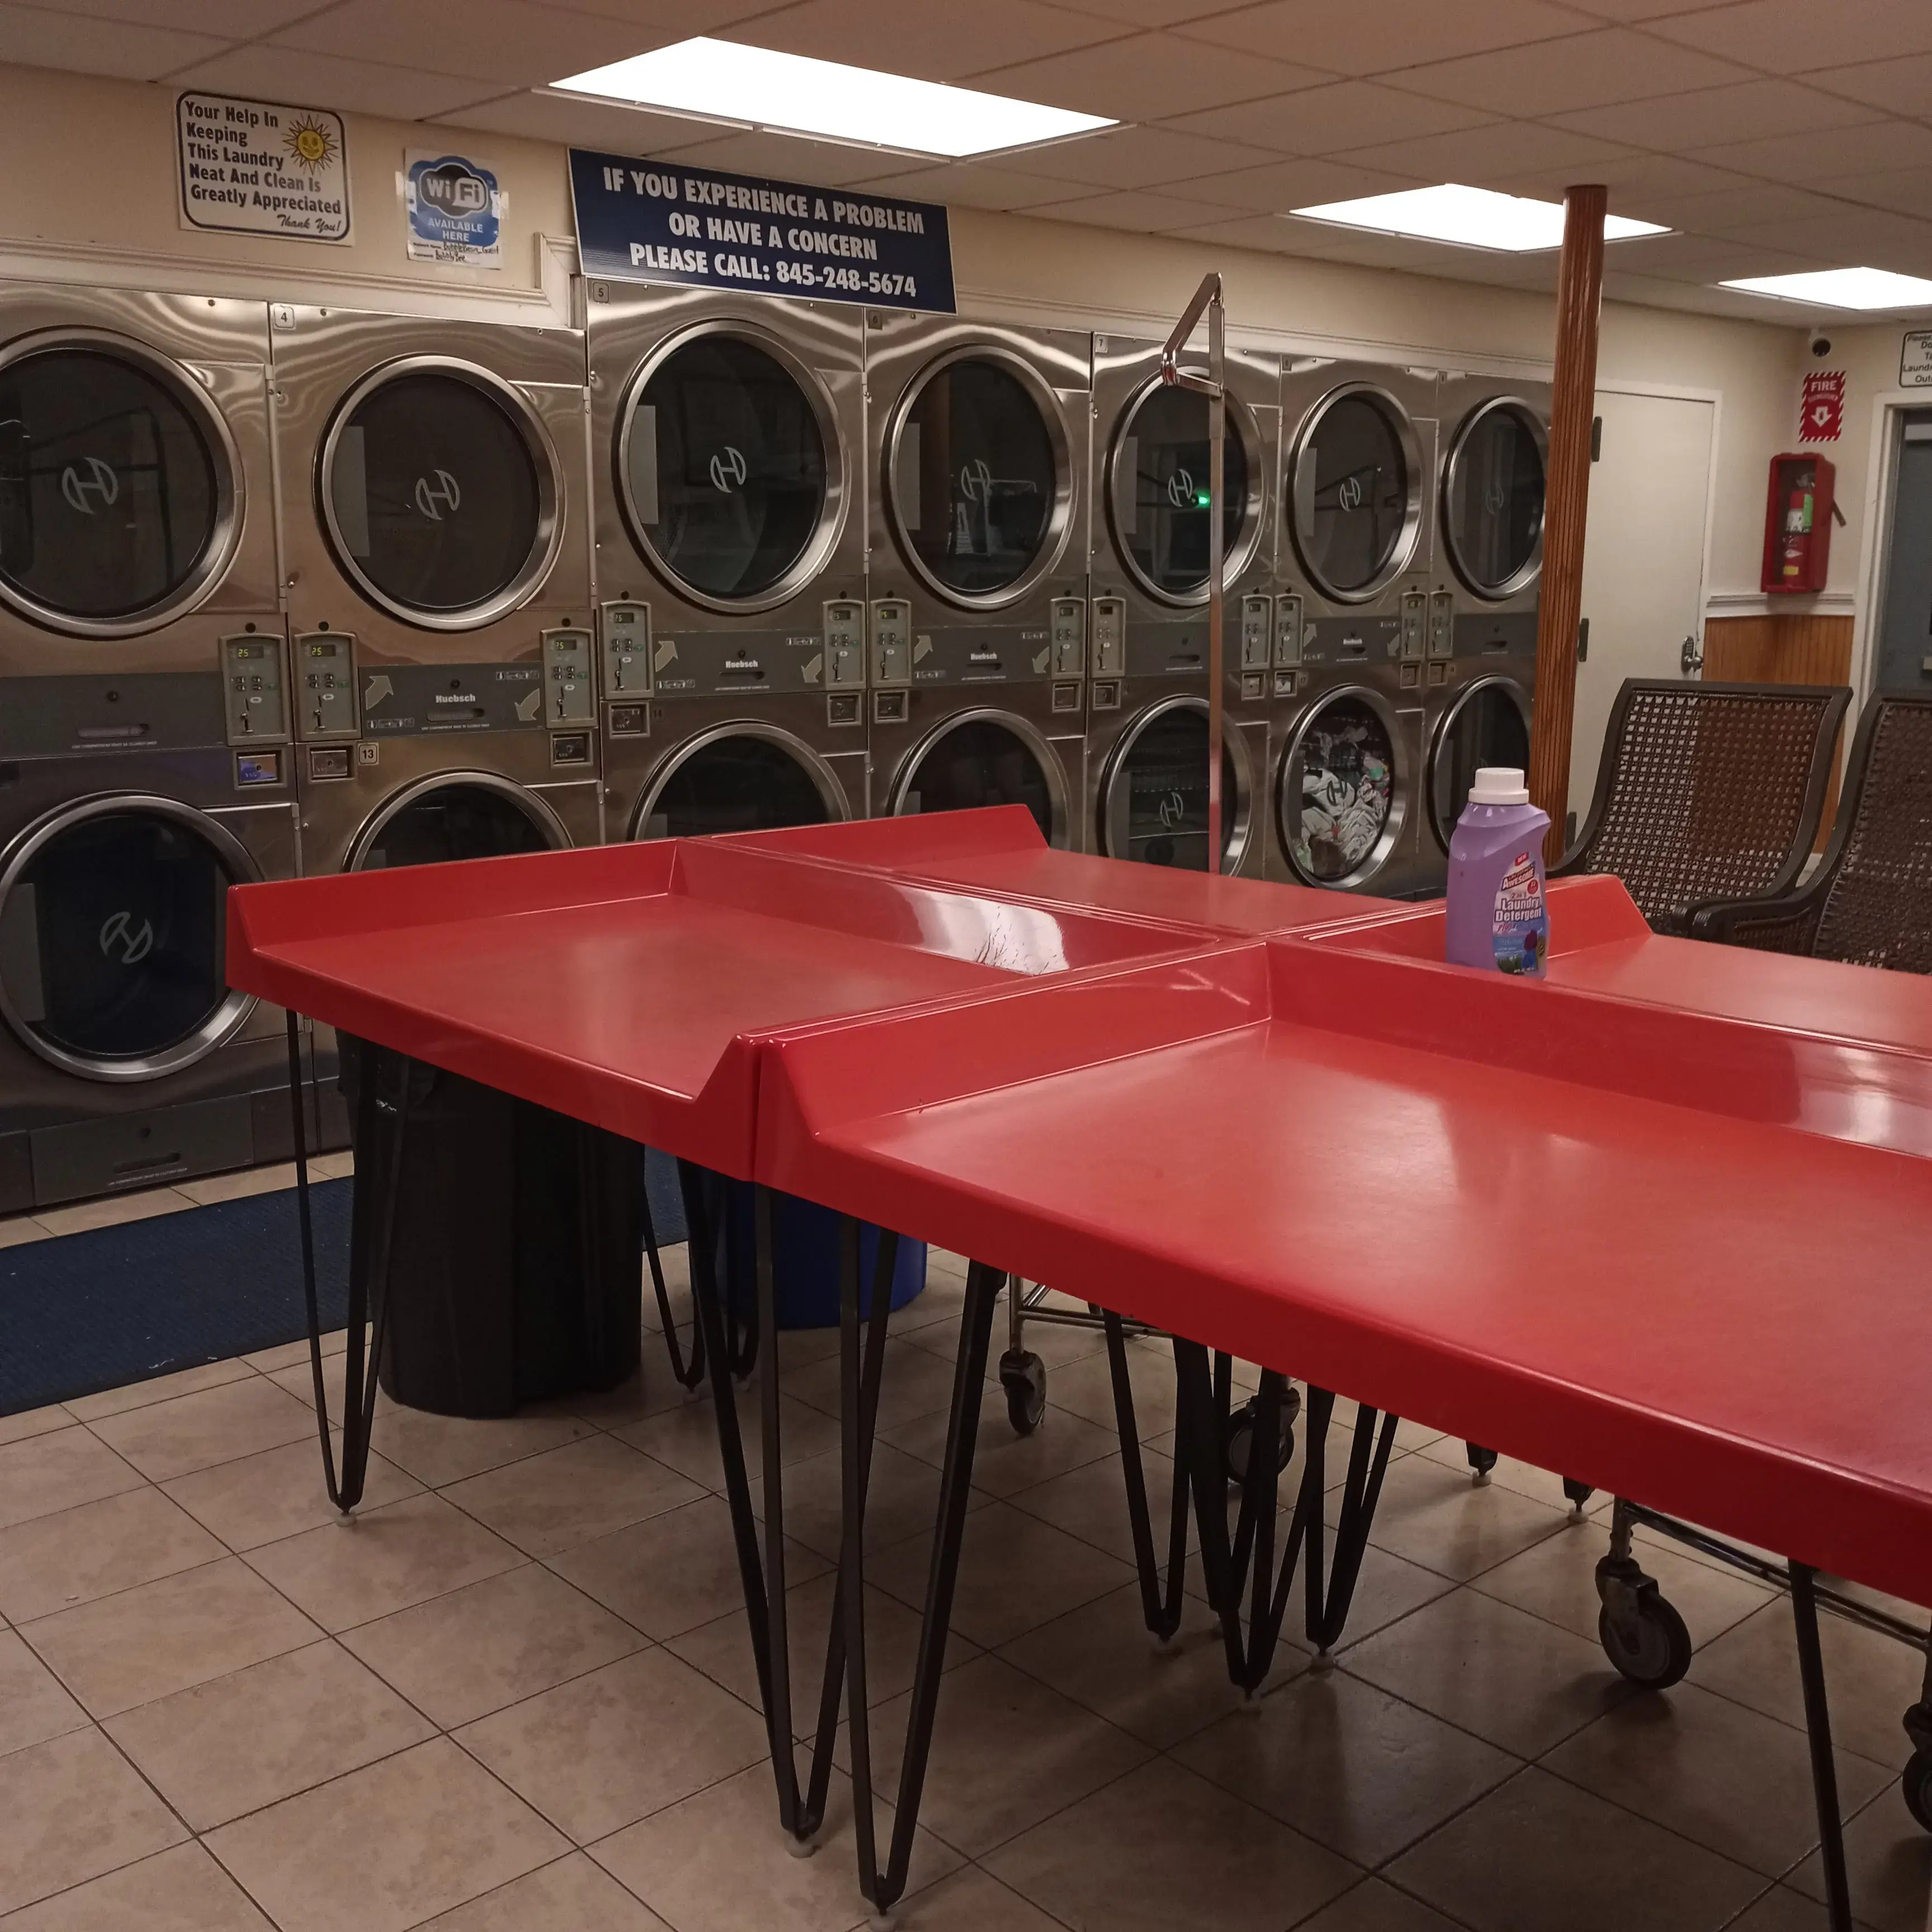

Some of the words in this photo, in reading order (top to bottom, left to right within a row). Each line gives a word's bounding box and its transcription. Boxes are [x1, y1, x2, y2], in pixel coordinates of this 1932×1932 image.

[184, 101, 220, 120] Your
[225, 106, 259, 128] Help
[264, 111, 278, 127] In
[186, 121, 248, 148] Keeping
[188, 142, 219, 160] This
[224, 147, 284, 171] Laundry
[189, 163, 225, 182] Neat
[230, 168, 259, 186] And
[264, 172, 304, 191] Clean
[309, 177, 321, 192] Is
[191, 184, 247, 207] Greatly
[253, 191, 341, 214] Appreciated
[603, 167, 624, 191] IF
[630, 171, 678, 200] YOU
[685, 178, 808, 218] EXPERIENCE
[814, 198, 828, 221] A
[832, 201, 924, 234] PROBLEM
[277, 214, 310, 229] Thank
[315, 216, 342, 234] You!
[428, 217, 484, 233] AVAILABLE
[442, 230, 470, 242] HERE
[669, 212, 702, 239] OR
[707, 216, 762, 247] HAVE
[768, 226, 783, 249] A
[788, 228, 878, 261] CONCERN
[629, 242, 708, 274] PLEASE
[714, 253, 770, 281] CALL:
[776, 261, 916, 297] 845-248-5674
[598, 288, 604, 297] 5
[281, 311, 288, 323] 4
[1098, 338, 1104, 347] 7
[1811, 380, 1837, 391] FIRE
[238, 648, 248, 657] 25
[311, 647, 322, 656] 25
[362, 749, 373, 759] 13
[1501, 897, 1540, 911] Laundry
[1495, 907, 1542, 922] Detergent
